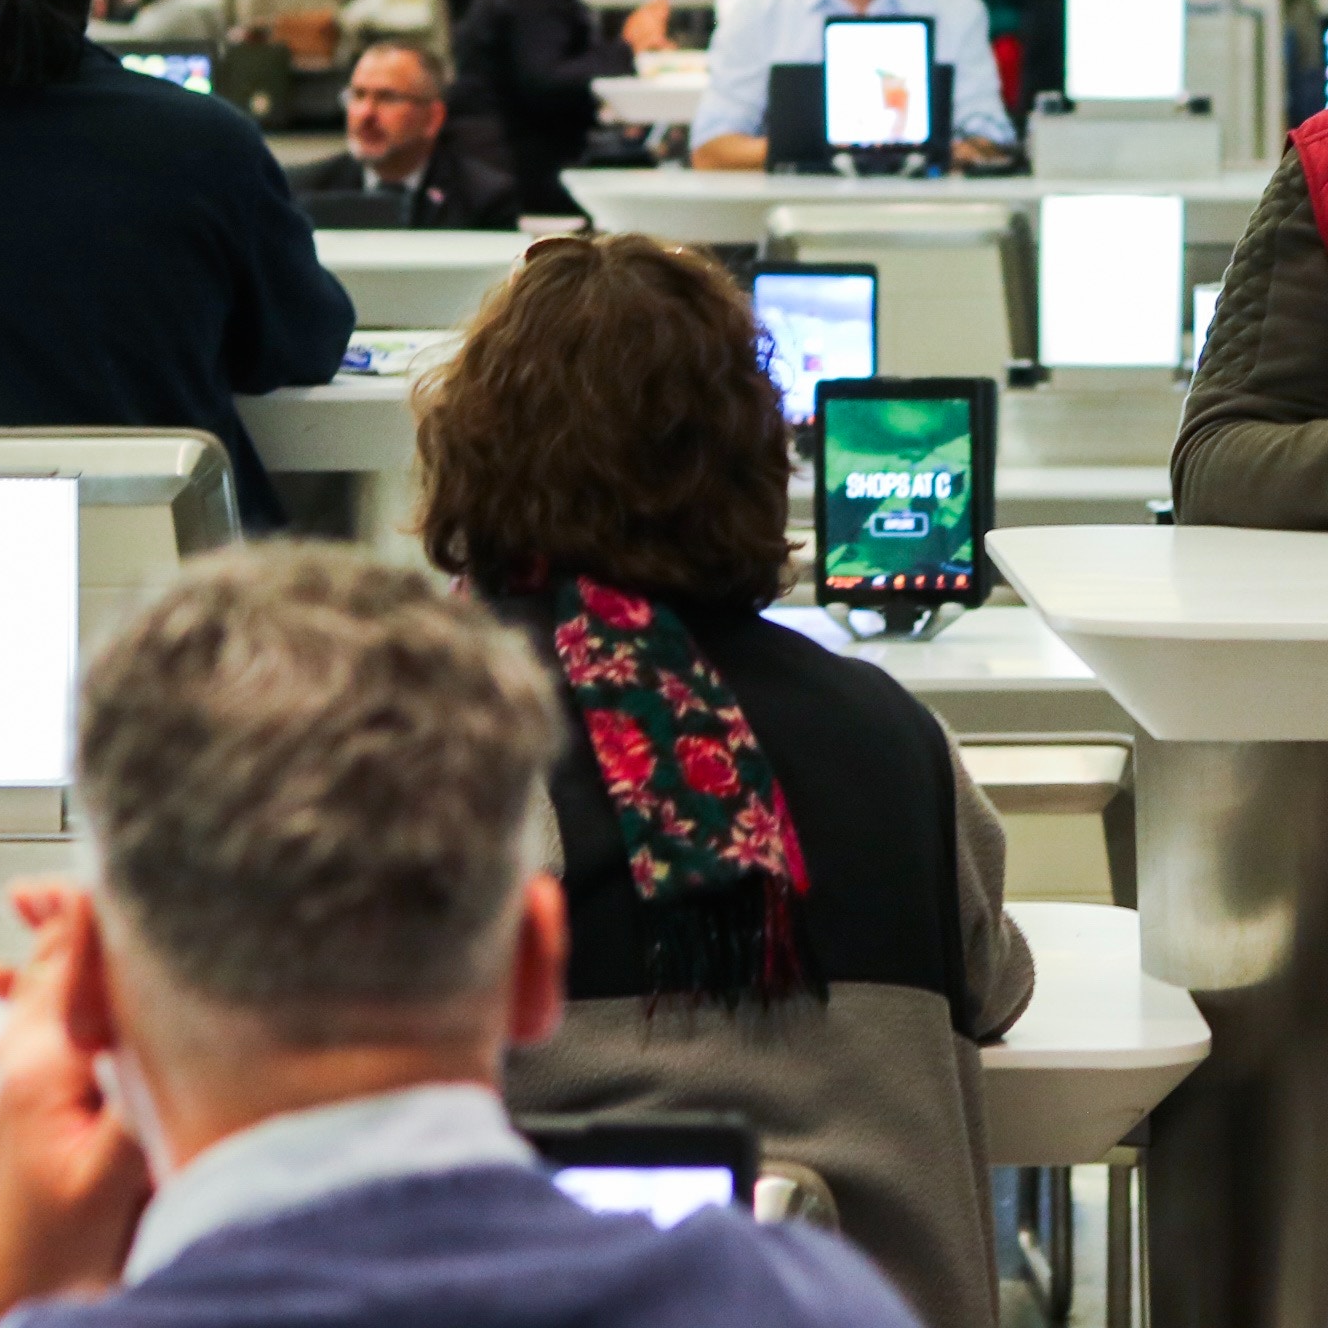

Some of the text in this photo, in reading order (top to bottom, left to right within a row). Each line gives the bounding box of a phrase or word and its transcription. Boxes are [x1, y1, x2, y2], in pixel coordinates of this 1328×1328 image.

[845, 471, 952, 501] SHOPS AT C
